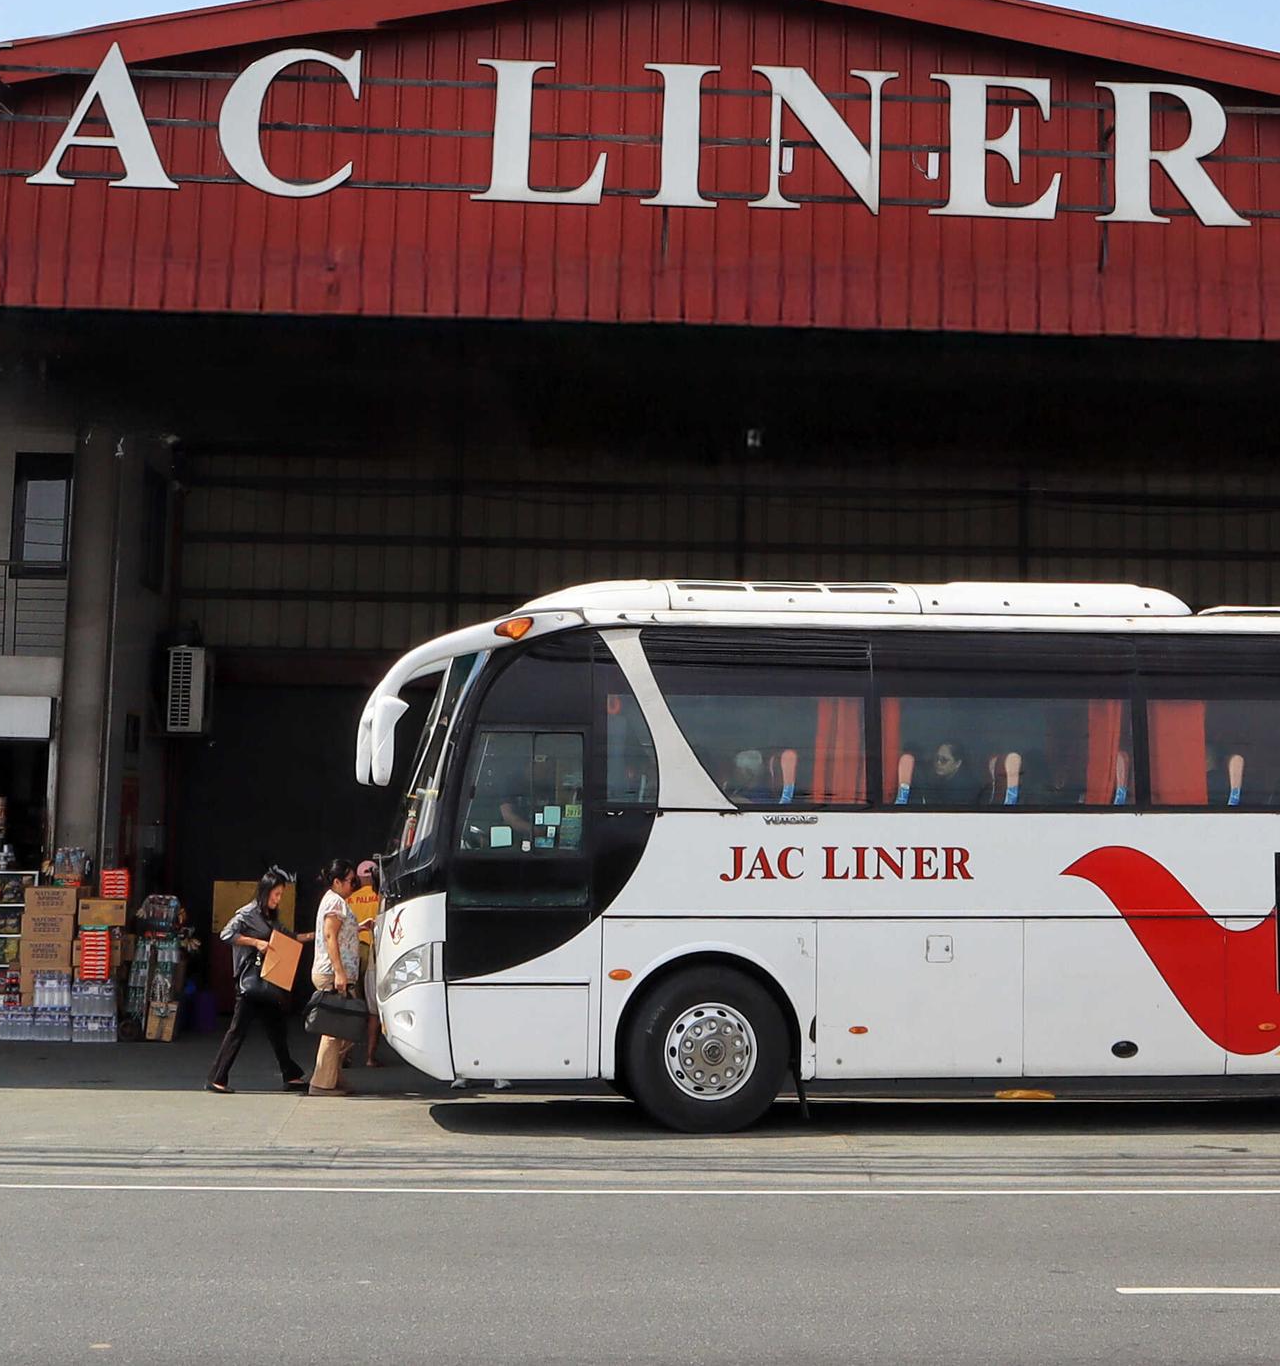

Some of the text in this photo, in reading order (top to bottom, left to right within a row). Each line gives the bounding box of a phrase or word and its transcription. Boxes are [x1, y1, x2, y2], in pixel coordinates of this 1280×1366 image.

[470, 58, 1252, 227] LINER
[762, 814, 818, 825] YUTONG
[719, 846, 974, 882] JAC LINER
